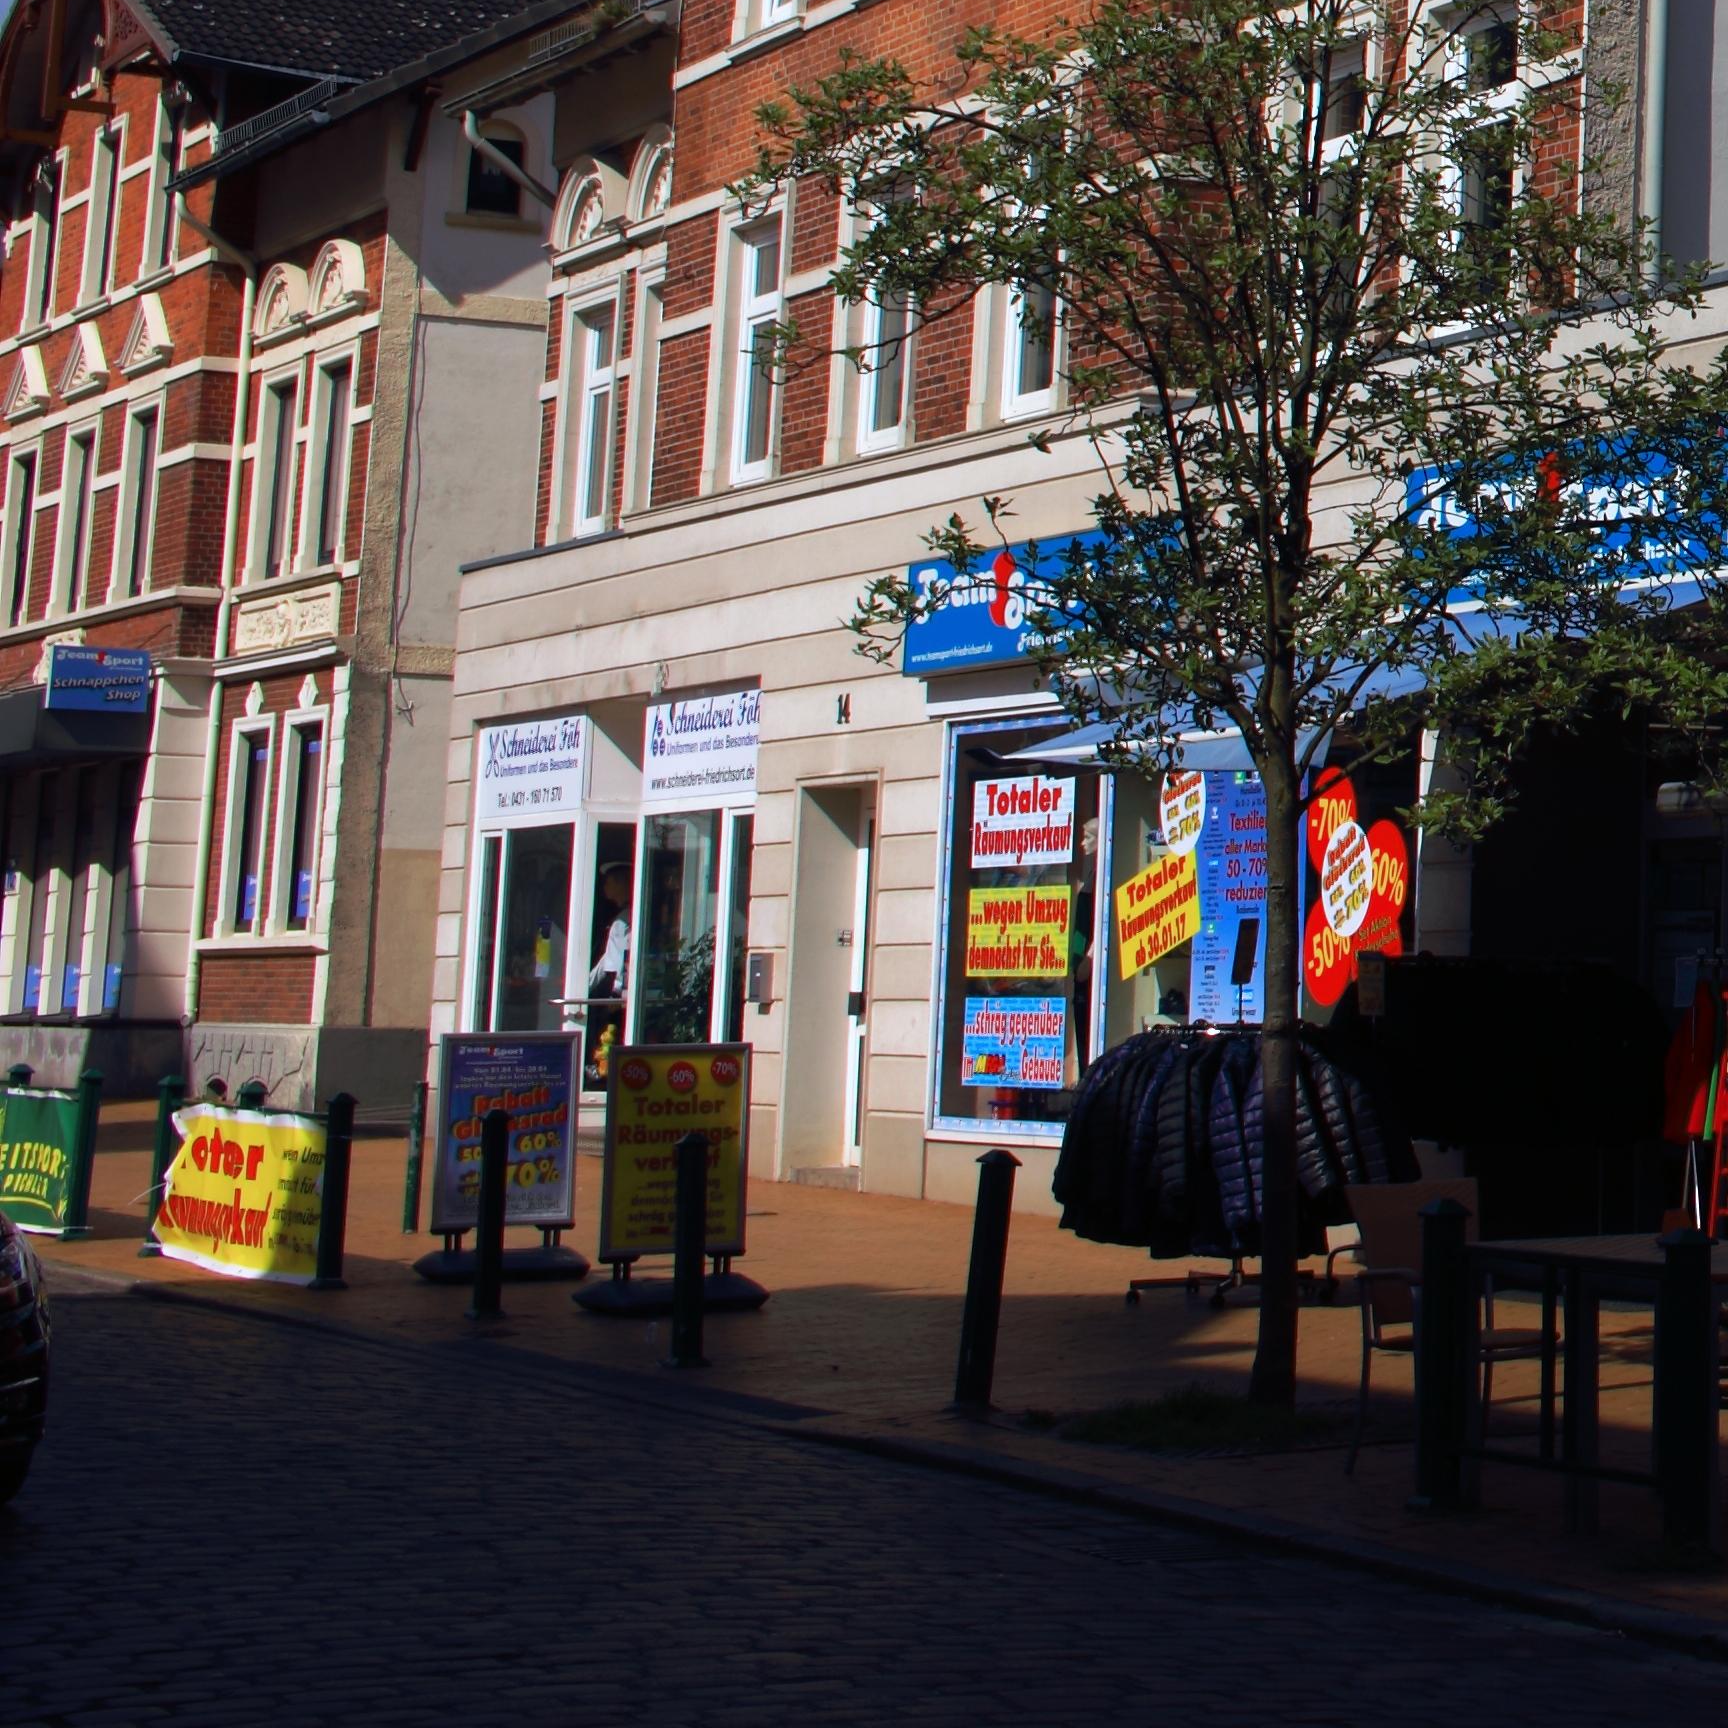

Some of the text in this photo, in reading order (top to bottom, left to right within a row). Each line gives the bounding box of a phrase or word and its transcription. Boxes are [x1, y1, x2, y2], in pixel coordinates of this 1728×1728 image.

[914, 569, 997, 624] Team
[57, 649, 143, 667] Team Sport
[106, 690, 140, 702] Shop
[836, 693, 850, 724] 14
[667, 697, 734, 736] Schneiderei
[500, 725, 556, 759] Schneiderei
[699, 737, 711, 752] und
[712, 736, 724, 750] das
[527, 761, 538, 774] und
[539, 760, 549, 773] das
[986, 777, 1062, 816] Totaler
[1230, 809, 1265, 832] Textilie
[974, 812, 1073, 864] Räumungsverkauf
[1244, 836, 1267, 853] Mark
[1127, 856, 1186, 907] Totaler
[1225, 880, 1267, 901] reduzier
[1026, 890, 1068, 934] Umzug
[1120, 868, 1196, 943] Räumungsverkauf
[969, 935, 1021, 970] demnächst
[1023, 934, 1037, 969] für
[1136, 938, 1146, 968] ab
[1148, 913, 1186, 960] 30.01.17
[1009, 1001, 1063, 1045] gegenüber
[669, 1071, 695, 1083] -60%
[712, 1062, 736, 1076] -70%
[1022, 1045, 1061, 1082] Gebäude
[475, 1086, 549, 1115] Rabatt
[634, 1094, 725, 1117] Totaler
